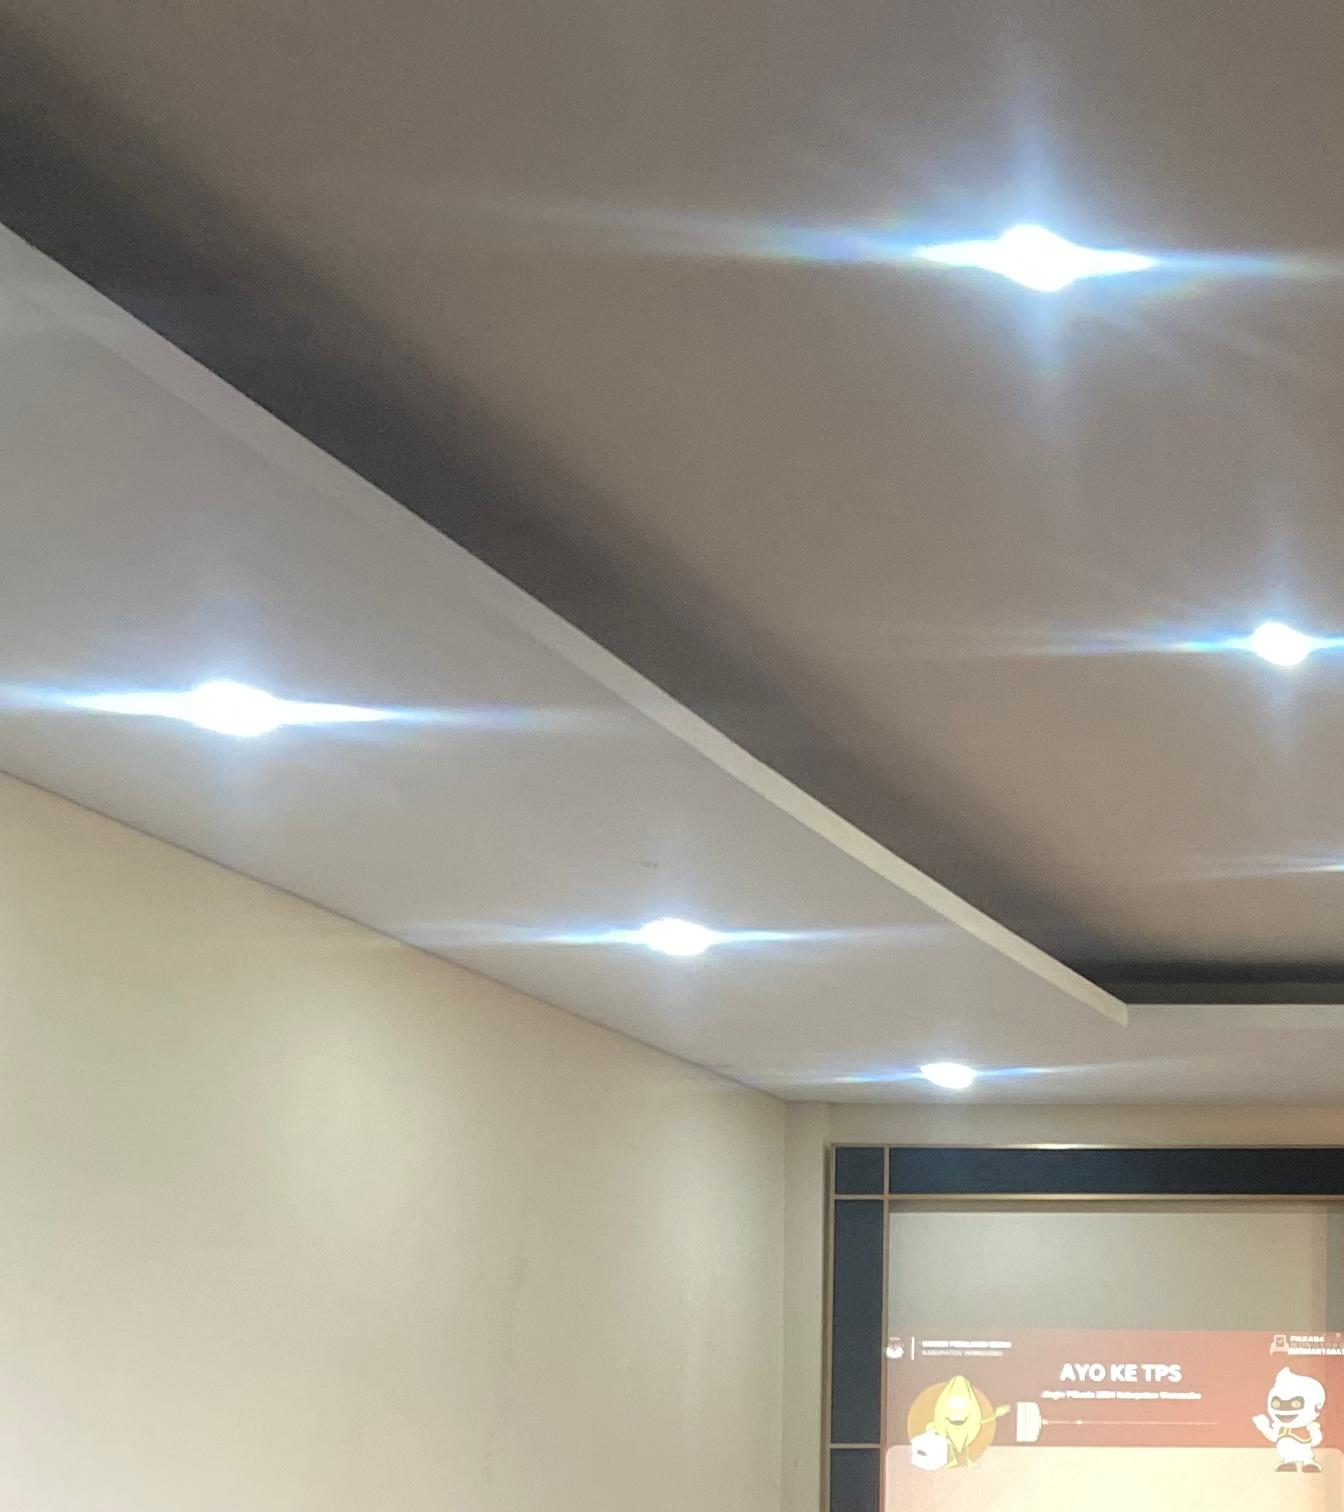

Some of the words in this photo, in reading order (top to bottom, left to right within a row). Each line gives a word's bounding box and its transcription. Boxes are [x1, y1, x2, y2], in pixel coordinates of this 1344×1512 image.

[1059, 1363, 1106, 1382] AYO
[1110, 1363, 1138, 1382] KE
[1141, 1363, 1183, 1382] TPS
